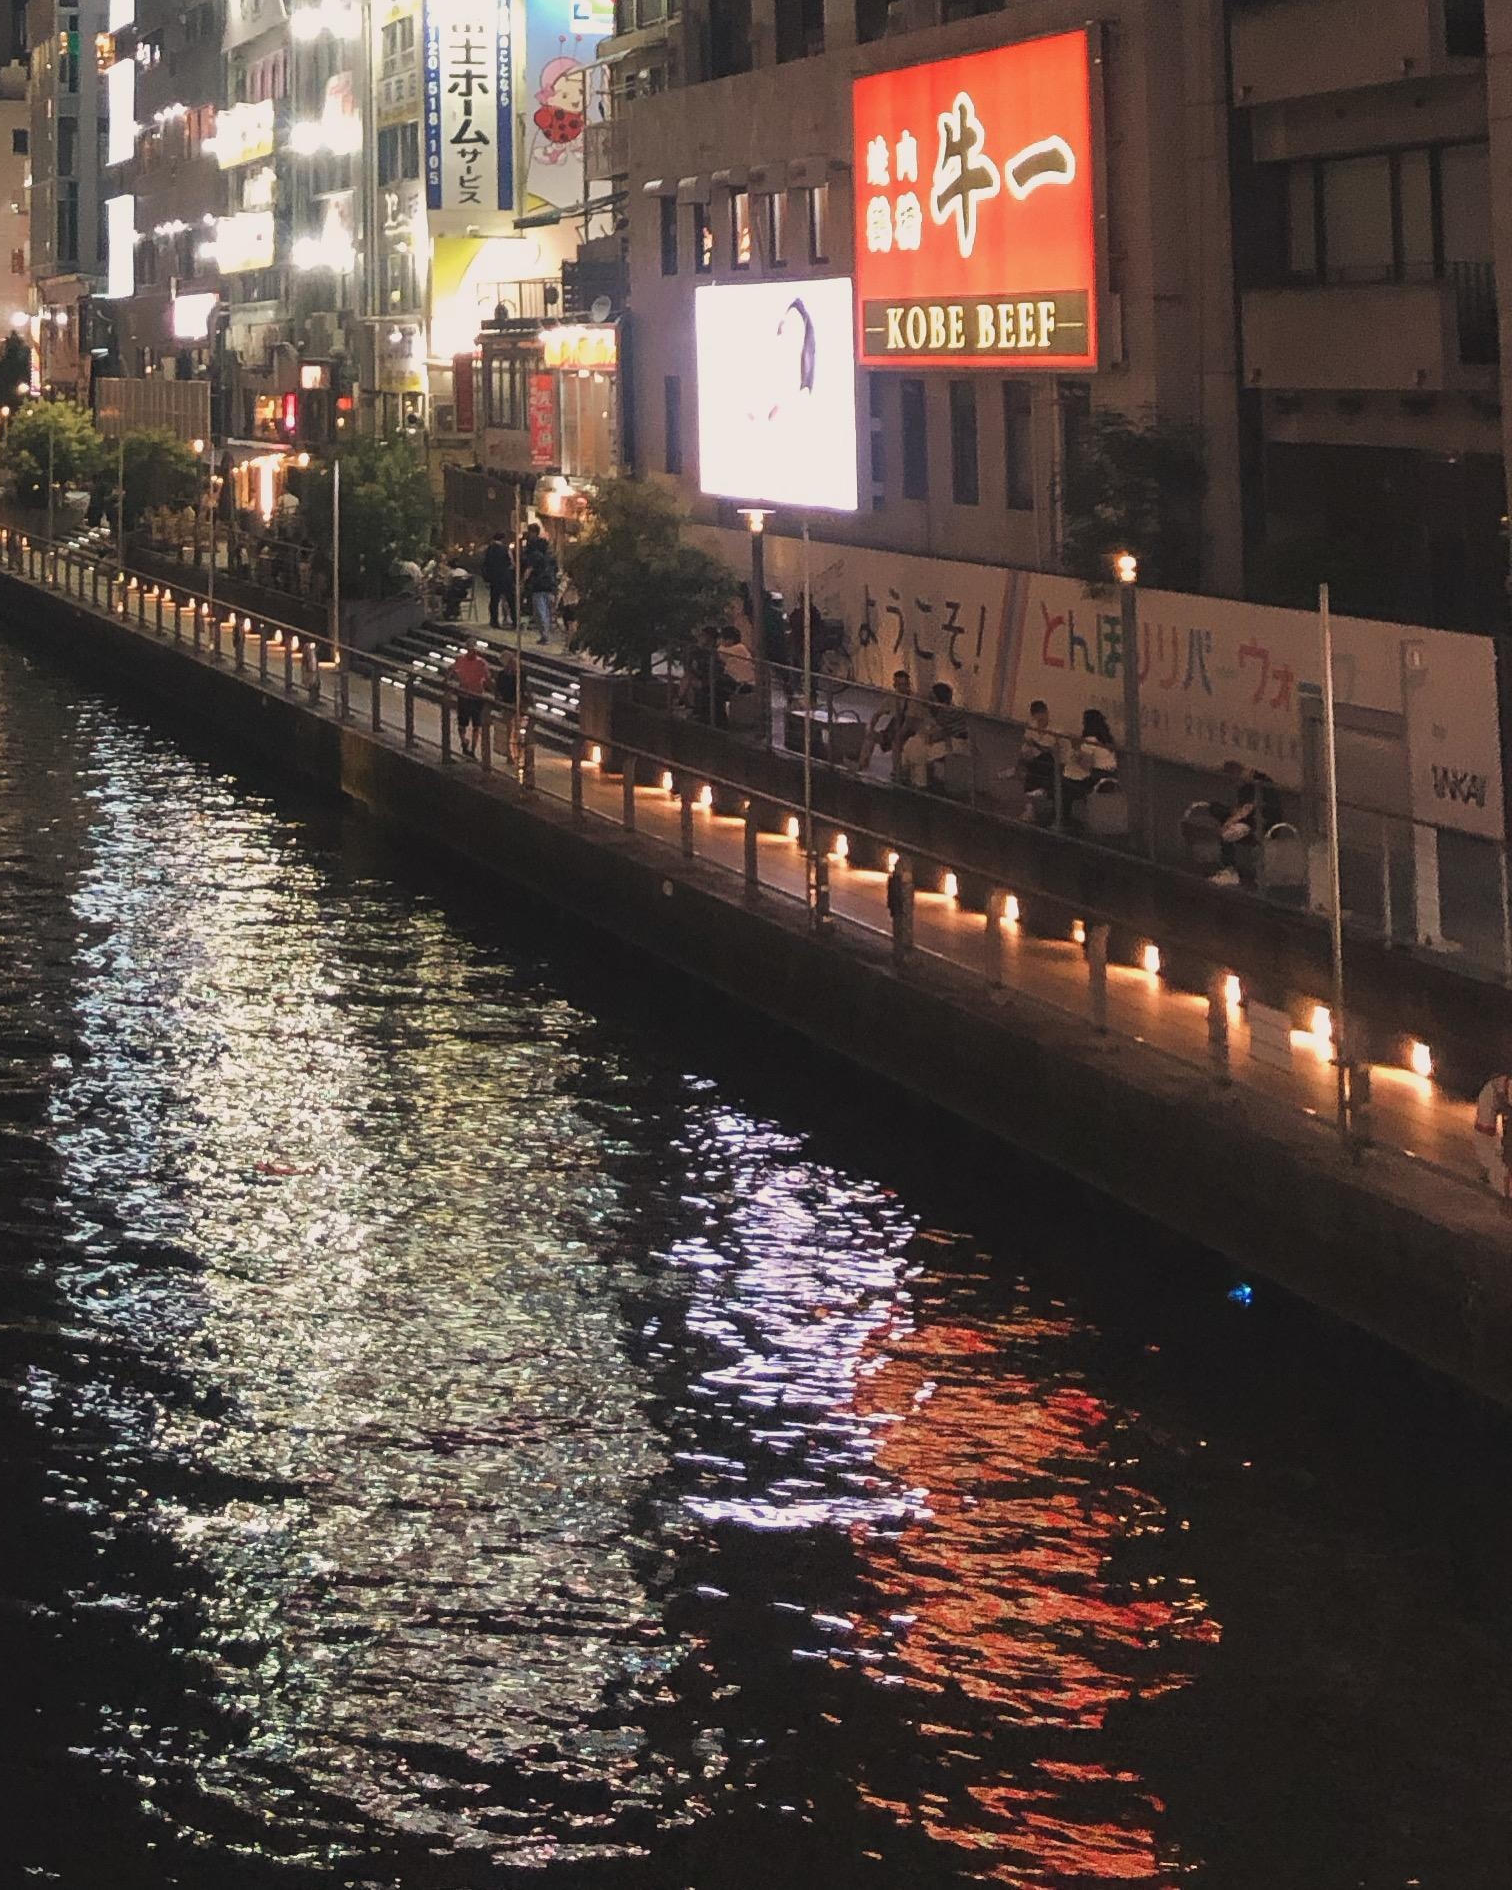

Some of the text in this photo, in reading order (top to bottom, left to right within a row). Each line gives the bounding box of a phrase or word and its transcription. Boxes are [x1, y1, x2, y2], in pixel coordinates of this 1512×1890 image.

[930, 90, 1077, 259] 牛一
[886, 300, 1057, 351] KOBE BEEF
